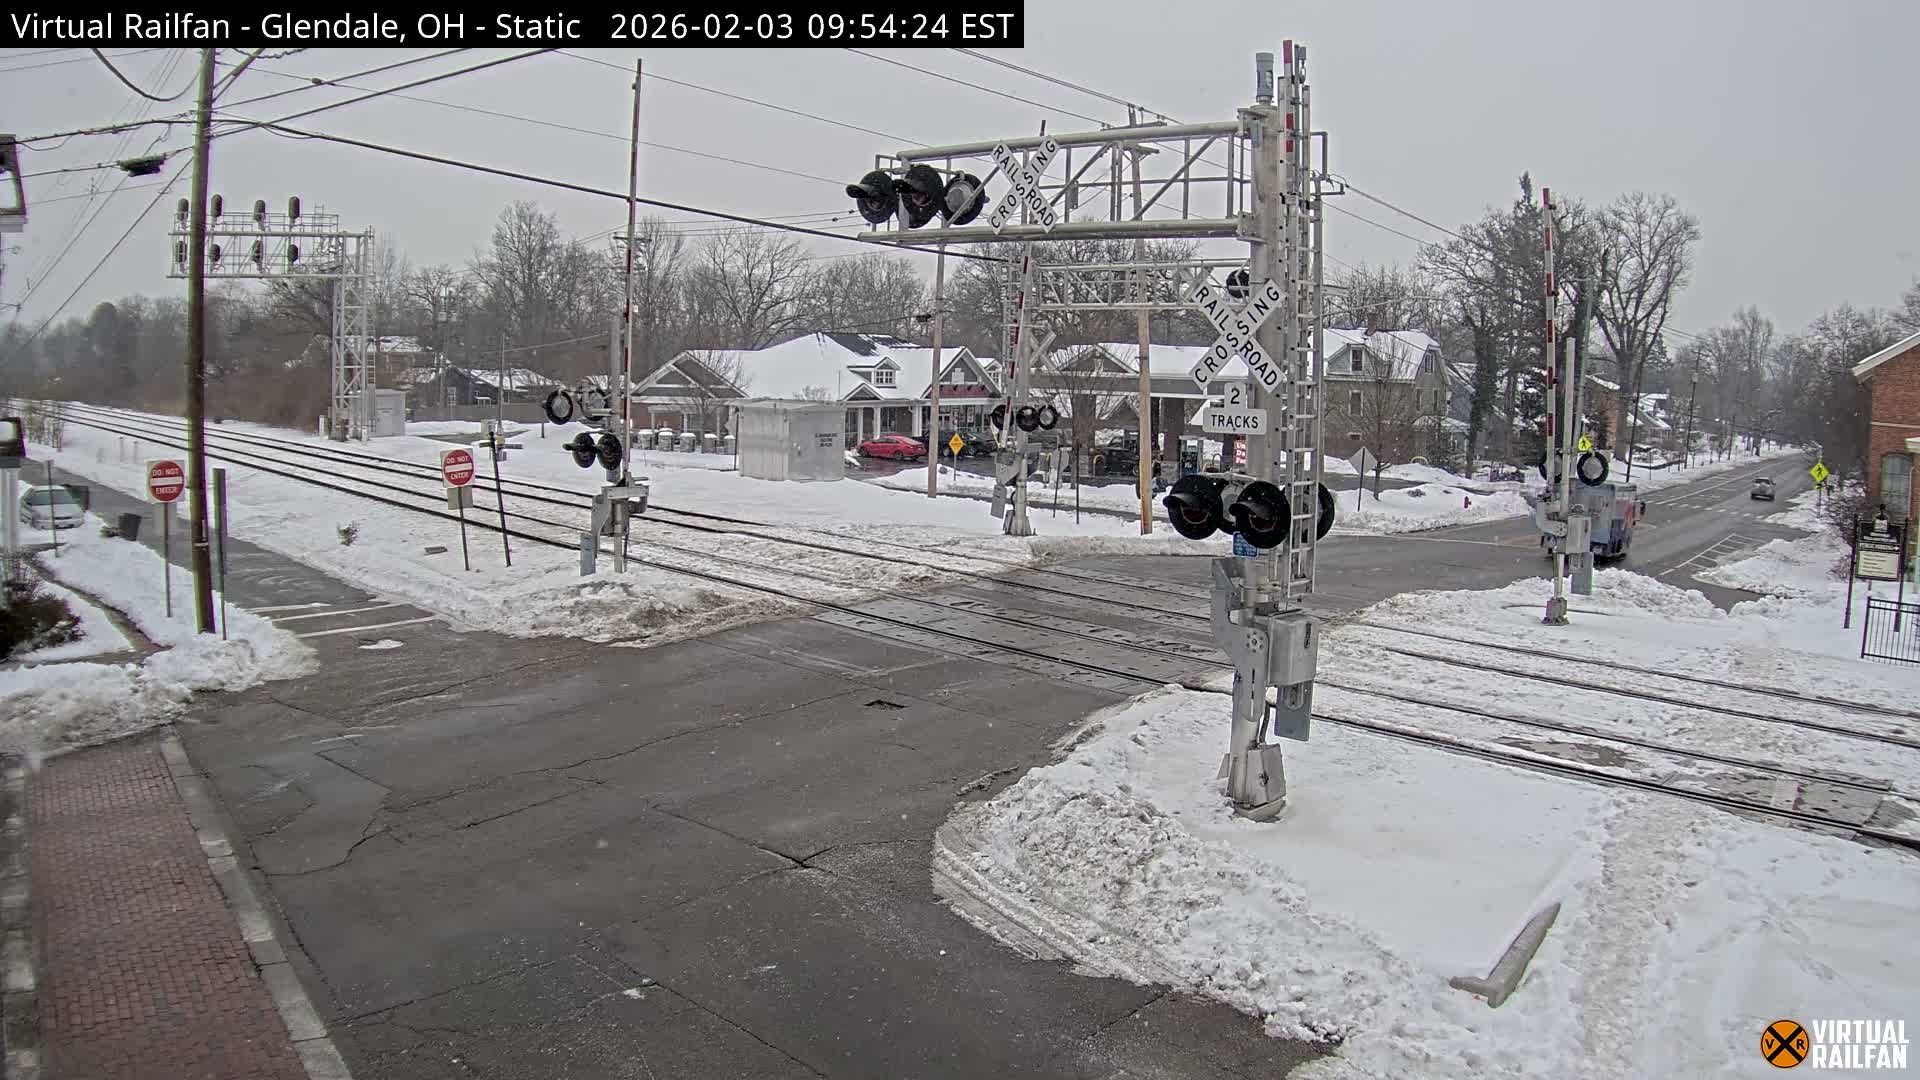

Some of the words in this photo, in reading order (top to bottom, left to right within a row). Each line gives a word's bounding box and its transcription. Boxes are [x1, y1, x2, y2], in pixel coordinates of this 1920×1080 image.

[991, 140, 1056, 229] CROSSING
[1194, 286, 1280, 383] CROSSING
[1230, 388, 1240, 405] 2
[1211, 414, 1259, 429] TRACKS
[450, 471, 469, 480] ENTER
